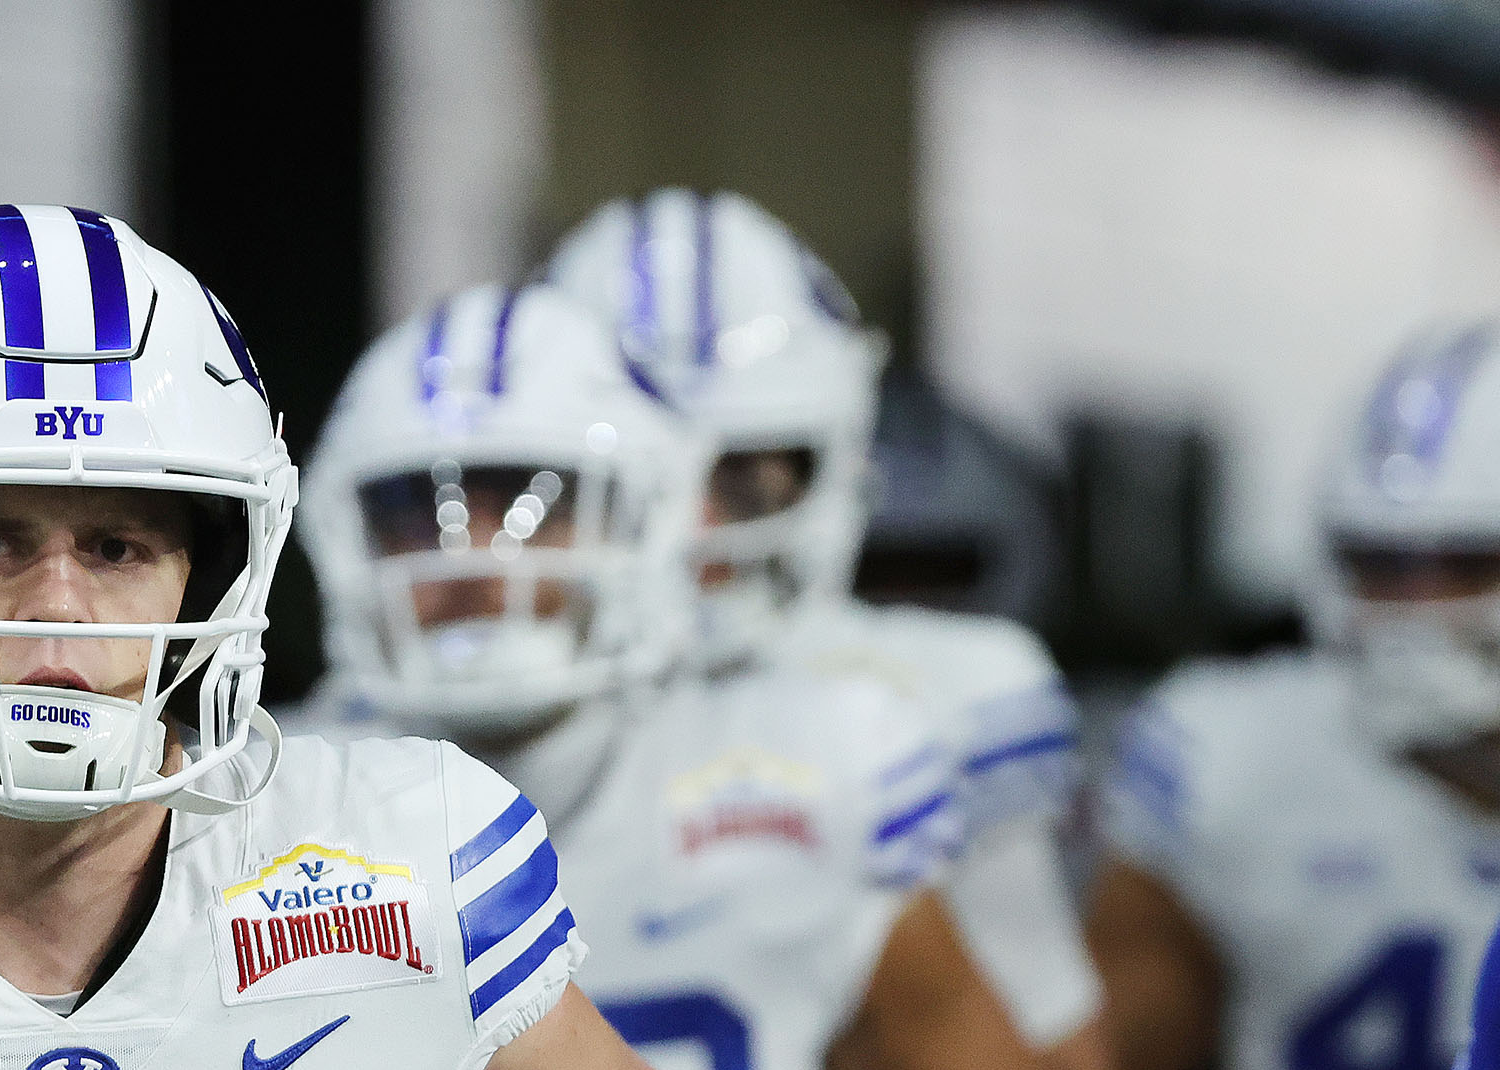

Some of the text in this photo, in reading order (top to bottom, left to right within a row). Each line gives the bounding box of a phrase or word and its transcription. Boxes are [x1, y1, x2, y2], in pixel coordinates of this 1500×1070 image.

[35, 406, 104, 440] BYU
[11, 704, 91, 728] GO COUGS
[258, 881, 372, 912] Valero
